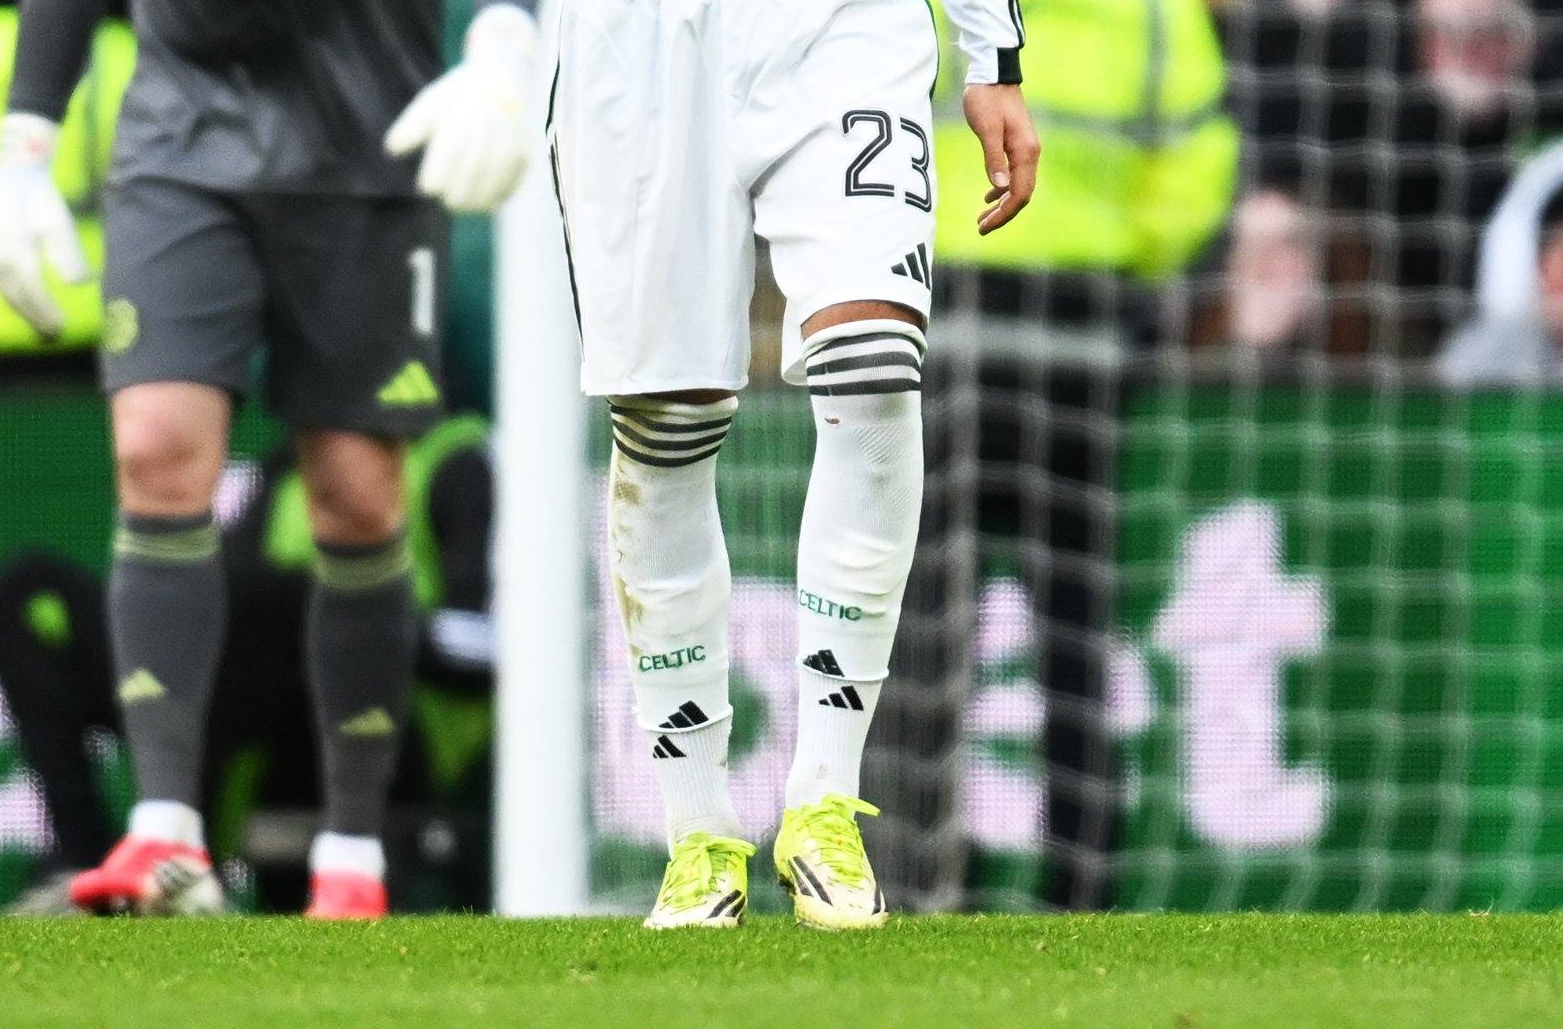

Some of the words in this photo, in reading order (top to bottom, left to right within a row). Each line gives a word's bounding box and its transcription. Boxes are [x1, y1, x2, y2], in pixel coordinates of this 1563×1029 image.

[841, 109, 933, 213] 23
[408, 248, 435, 336] 1
[798, 589, 863, 622] CELTIC
[638, 644, 707, 672] CELTIC
